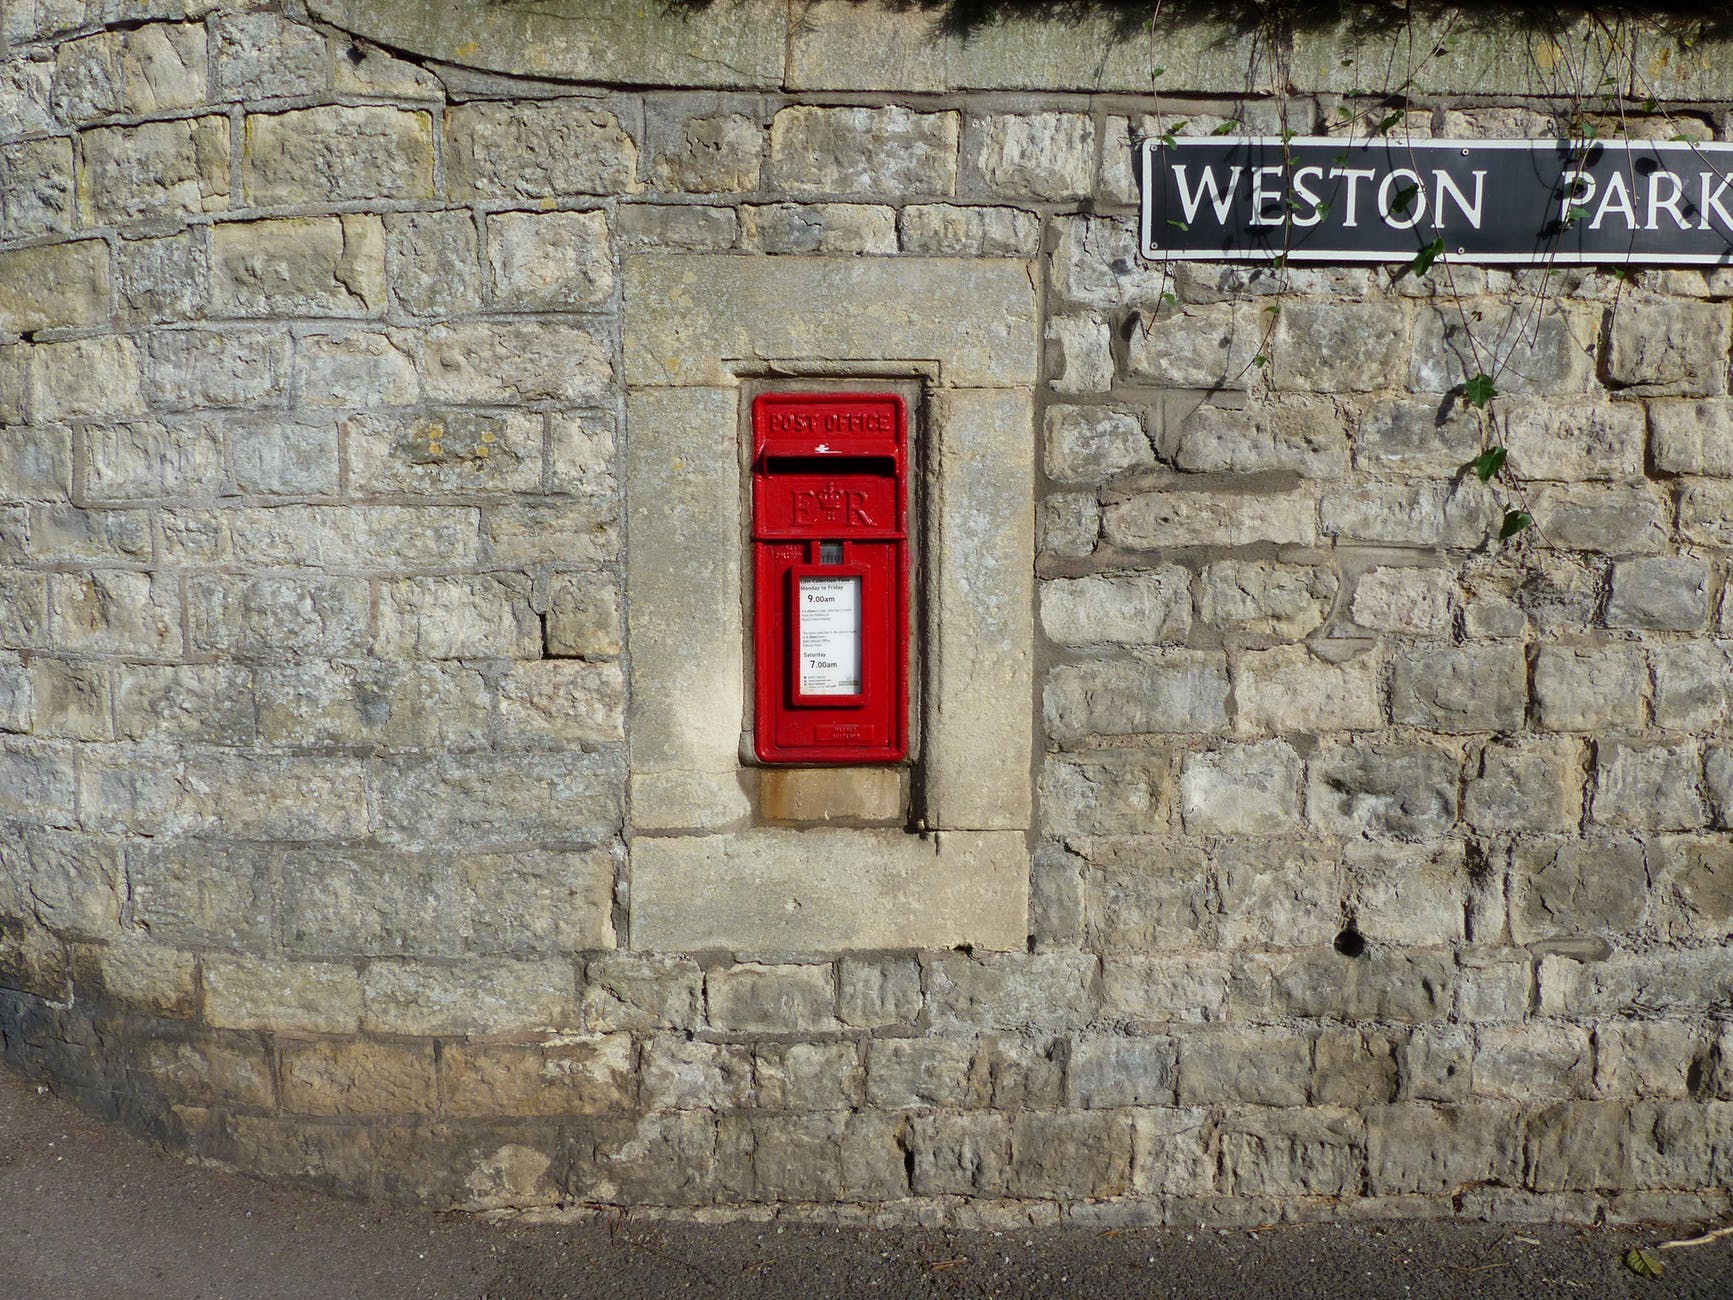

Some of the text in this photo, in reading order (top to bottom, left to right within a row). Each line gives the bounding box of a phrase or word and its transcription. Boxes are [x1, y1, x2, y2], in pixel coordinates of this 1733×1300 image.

[1171, 164, 1733, 231] WESTON PARK
[769, 413, 890, 432] POST OFFICE
[789, 490, 878, 527] E R
[807, 594, 835, 603] 9.00am
[810, 660, 837, 668] 7.00am
